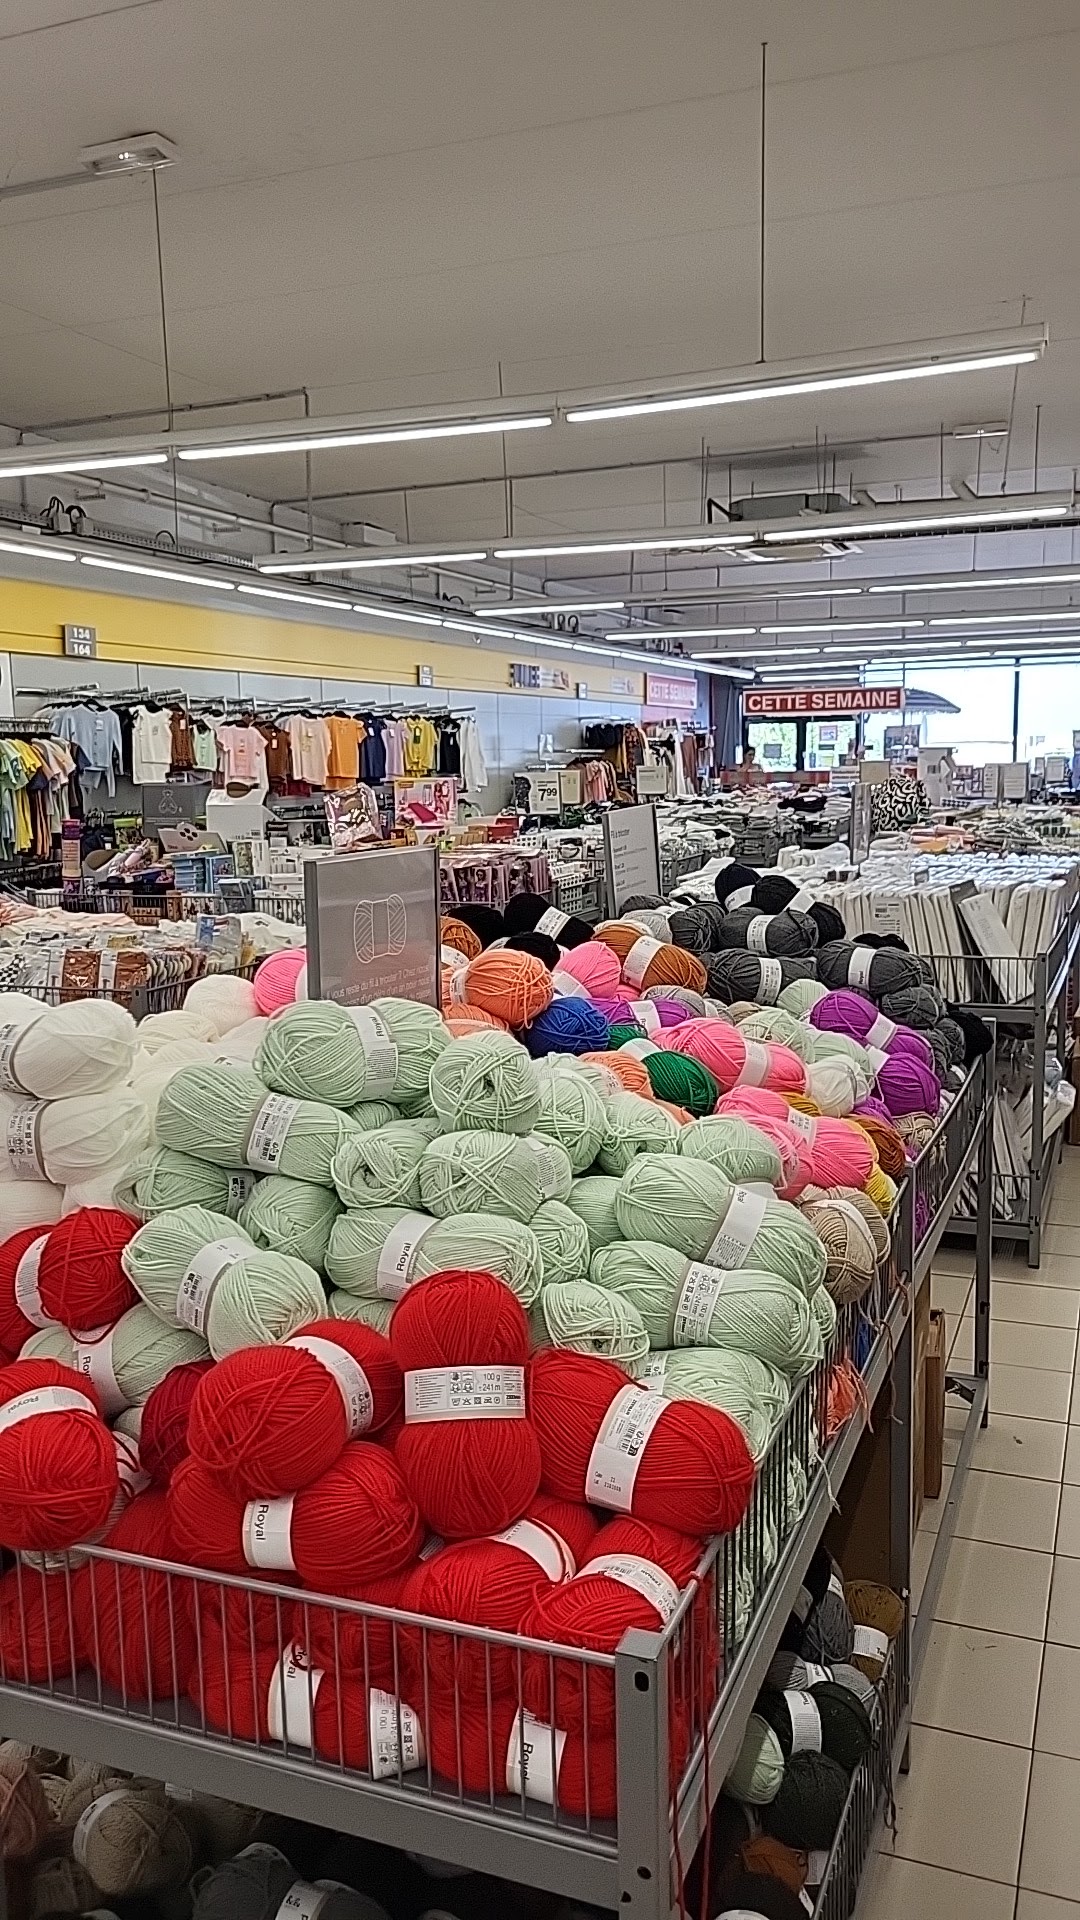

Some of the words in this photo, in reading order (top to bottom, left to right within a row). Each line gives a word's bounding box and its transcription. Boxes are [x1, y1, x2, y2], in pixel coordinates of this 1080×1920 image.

[72, 627, 91, 639] 134
[73, 643, 91, 656] 164
[748, 694, 807, 711] CETTE
[811, 691, 898, 709] SEMAINE
[368, 1016, 385, 1037] Royal
[395, 1242, 413, 1272] Royal
[483, 1372, 495, 1381] 100
[495, 1374, 501, 1382] g
[7, 1396, 39, 1414] Royal
[254, 1504, 270, 1541] Royal
[379, 1715, 388, 1730] 100
